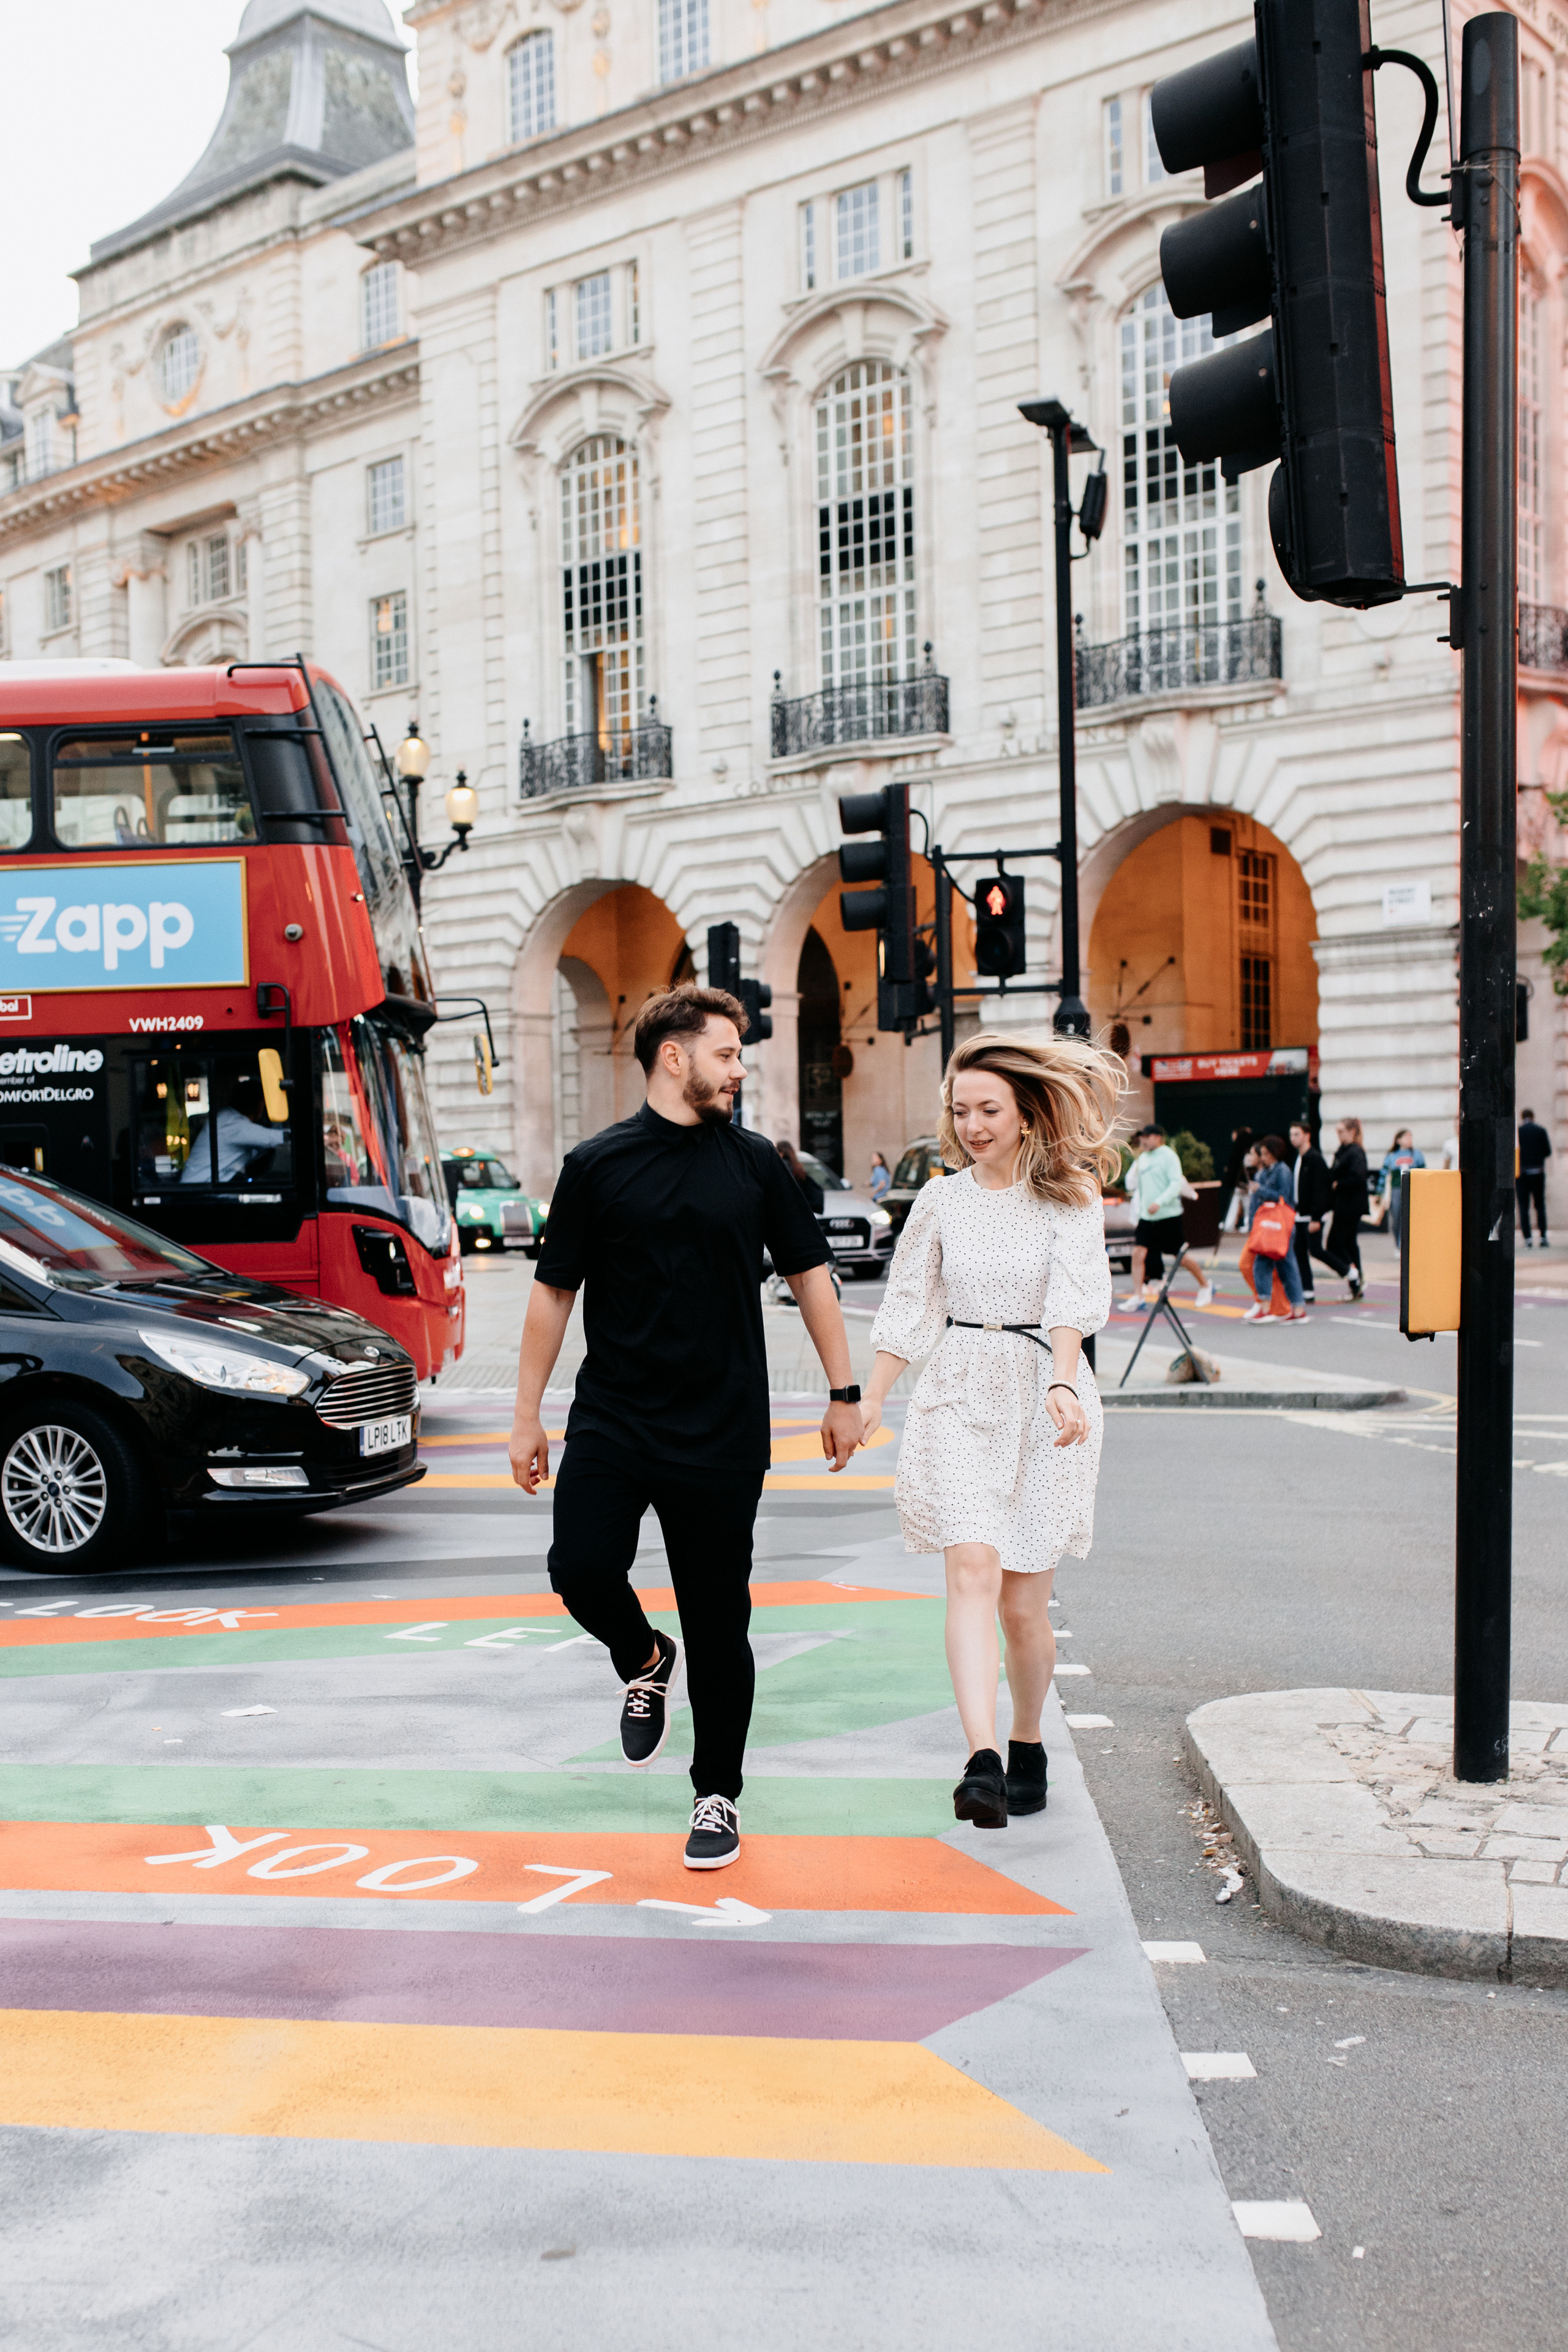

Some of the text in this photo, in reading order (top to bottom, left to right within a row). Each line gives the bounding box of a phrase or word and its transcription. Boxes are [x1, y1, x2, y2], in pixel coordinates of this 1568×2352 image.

[17, 897, 194, 970] Zapp
[0, 998, 18, 1012] bal
[129, 1016, 203, 1032] VWH2409
[0, 1044, 104, 1075] etroline
[391, 1419, 407, 1442] LTK
[14, 1600, 279, 1628] LOOK
[143, 1825, 614, 1914] LOOK
